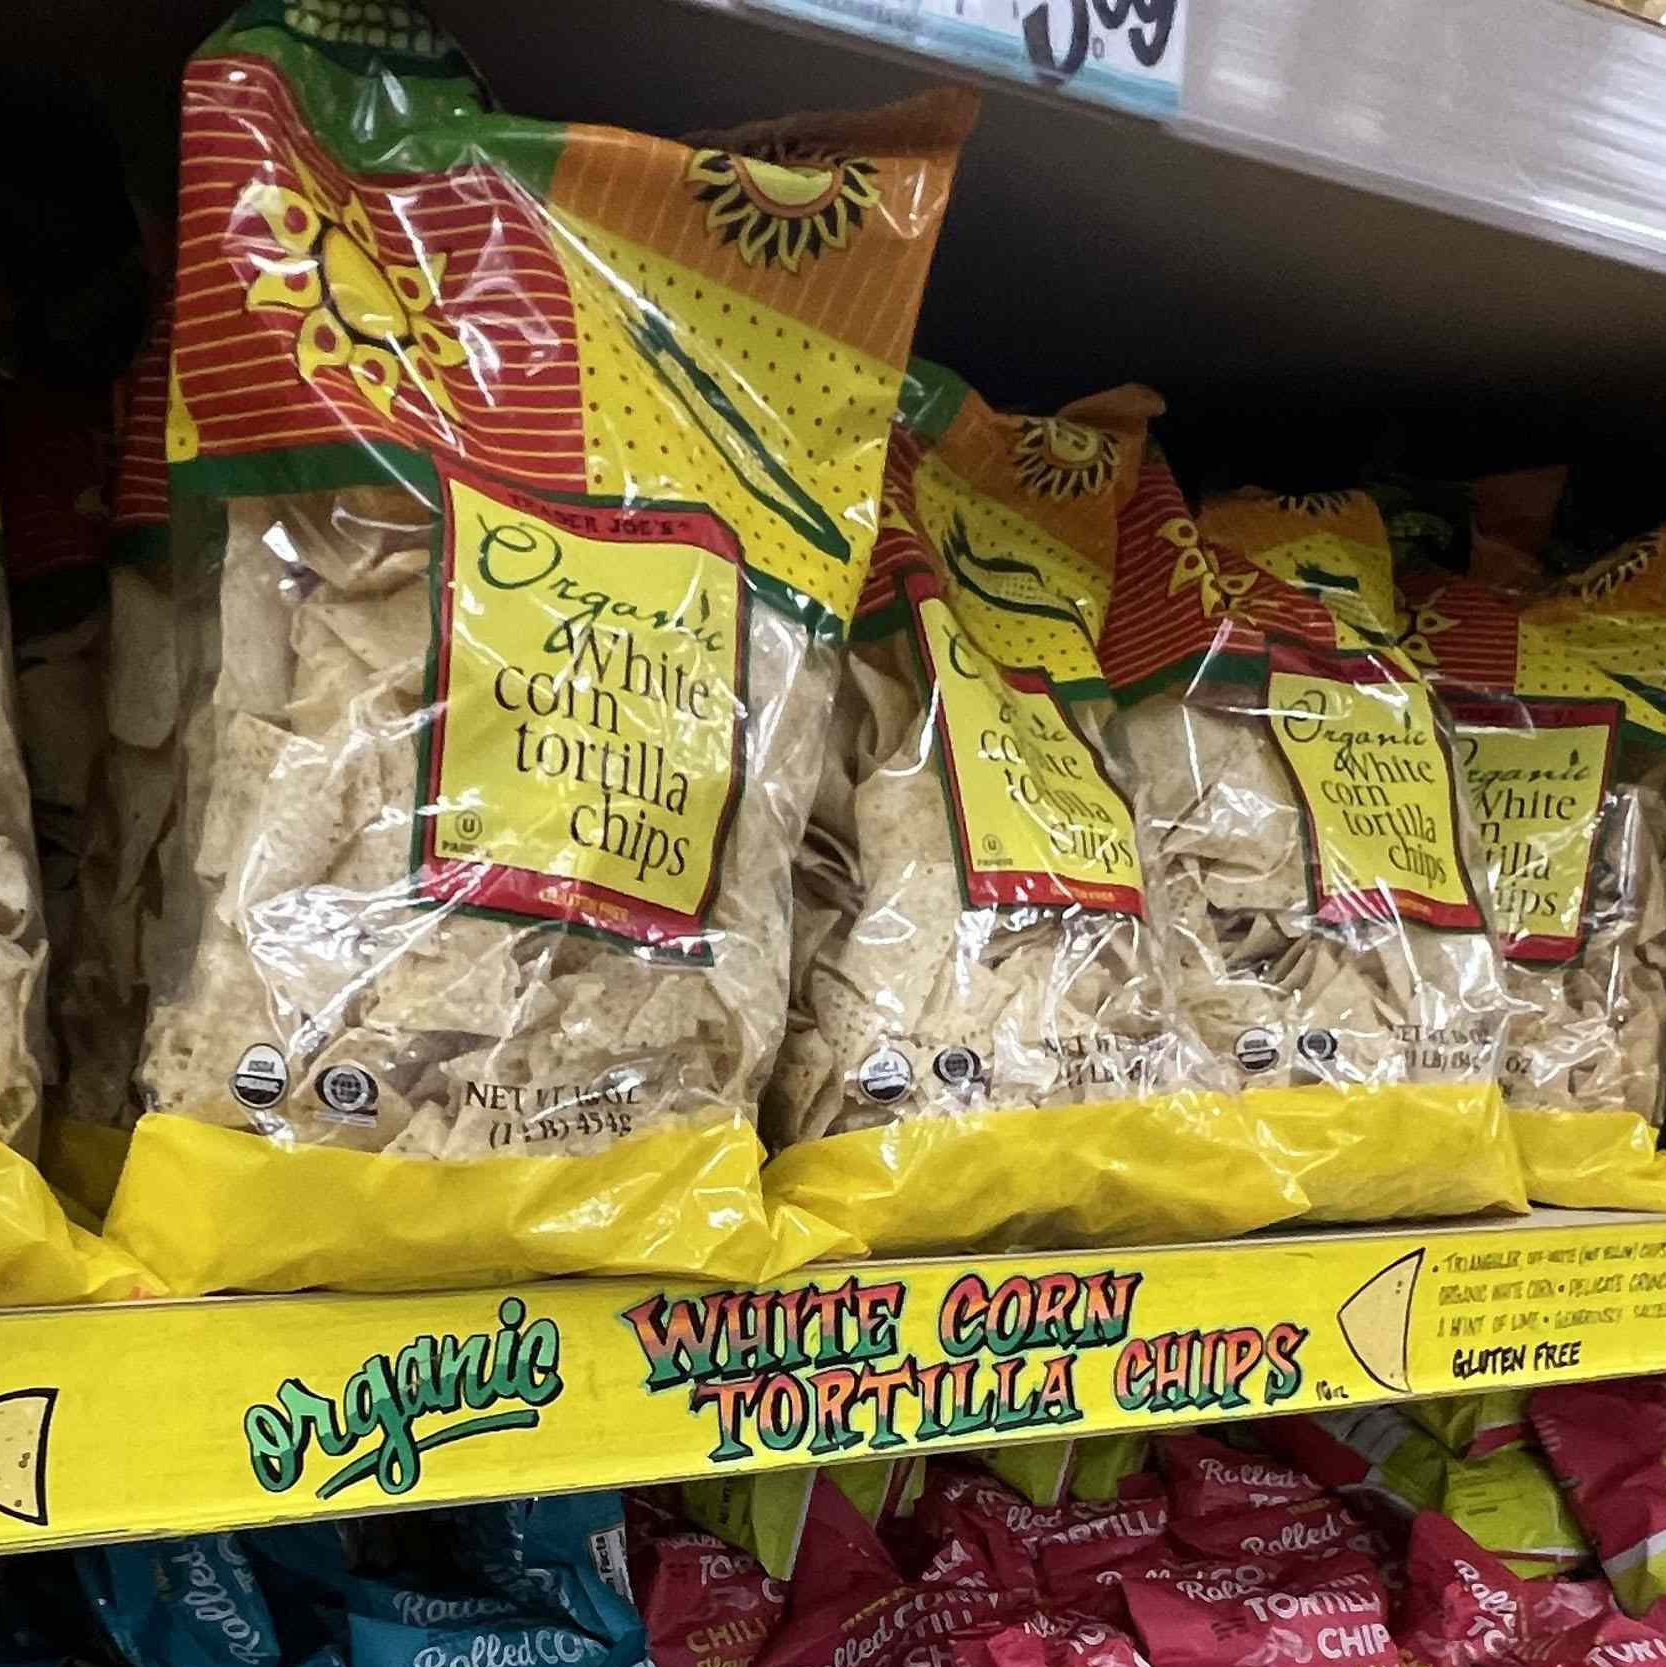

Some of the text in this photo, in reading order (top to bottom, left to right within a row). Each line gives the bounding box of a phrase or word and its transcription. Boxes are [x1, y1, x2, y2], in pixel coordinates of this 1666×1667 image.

[477, 513, 725, 653] Organic
[562, 618, 710, 719] White
[494, 663, 620, 735] corn
[1280, 689, 1428, 772] Organic
[515, 722, 691, 816] tortilla
[1320, 779, 1390, 806] corn
[1343, 749, 1436, 784] White
[569, 794, 691, 883] chips
[1341, 803, 1436, 843] tortilla
[1388, 840, 1447, 889] chips
[466, 1081, 524, 1110] NET
[574, 1111, 634, 1137] 454g
[617, 1268, 1146, 1392] WHITE CORN
[1452, 1340, 1582, 1379] GLUTEN FREE
[242, 1296, 565, 1497] organic
[688, 1319, 1312, 1464] TORTILLA CHIPS
[1199, 1458, 1297, 1488] Rolled
[1240, 1514, 1343, 1555] Rolled
